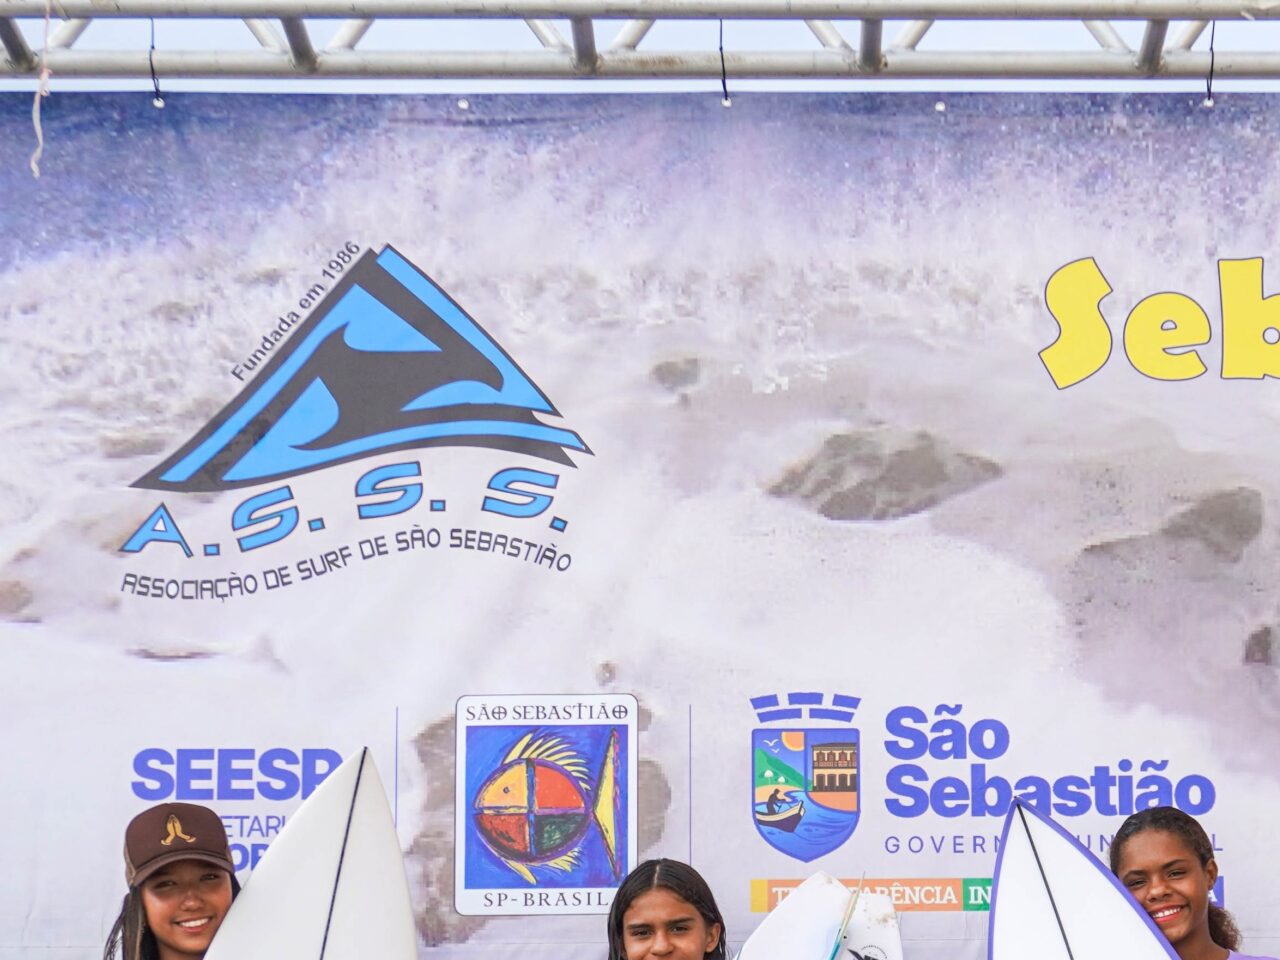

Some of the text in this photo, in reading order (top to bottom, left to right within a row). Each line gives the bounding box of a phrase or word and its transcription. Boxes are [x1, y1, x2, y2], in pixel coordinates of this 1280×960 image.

[230, 239, 362, 384] Fundada em 1986
[264, 567, 294, 590] DE
[297, 545, 352, 581] SURF
[361, 534, 389, 560] DE
[466, 703, 628, 721] SÃO SEBASTIÃO
[884, 704, 1010, 760] São
[132, 748, 344, 801] SEESP
[884, 759, 1217, 818] Sebastião
